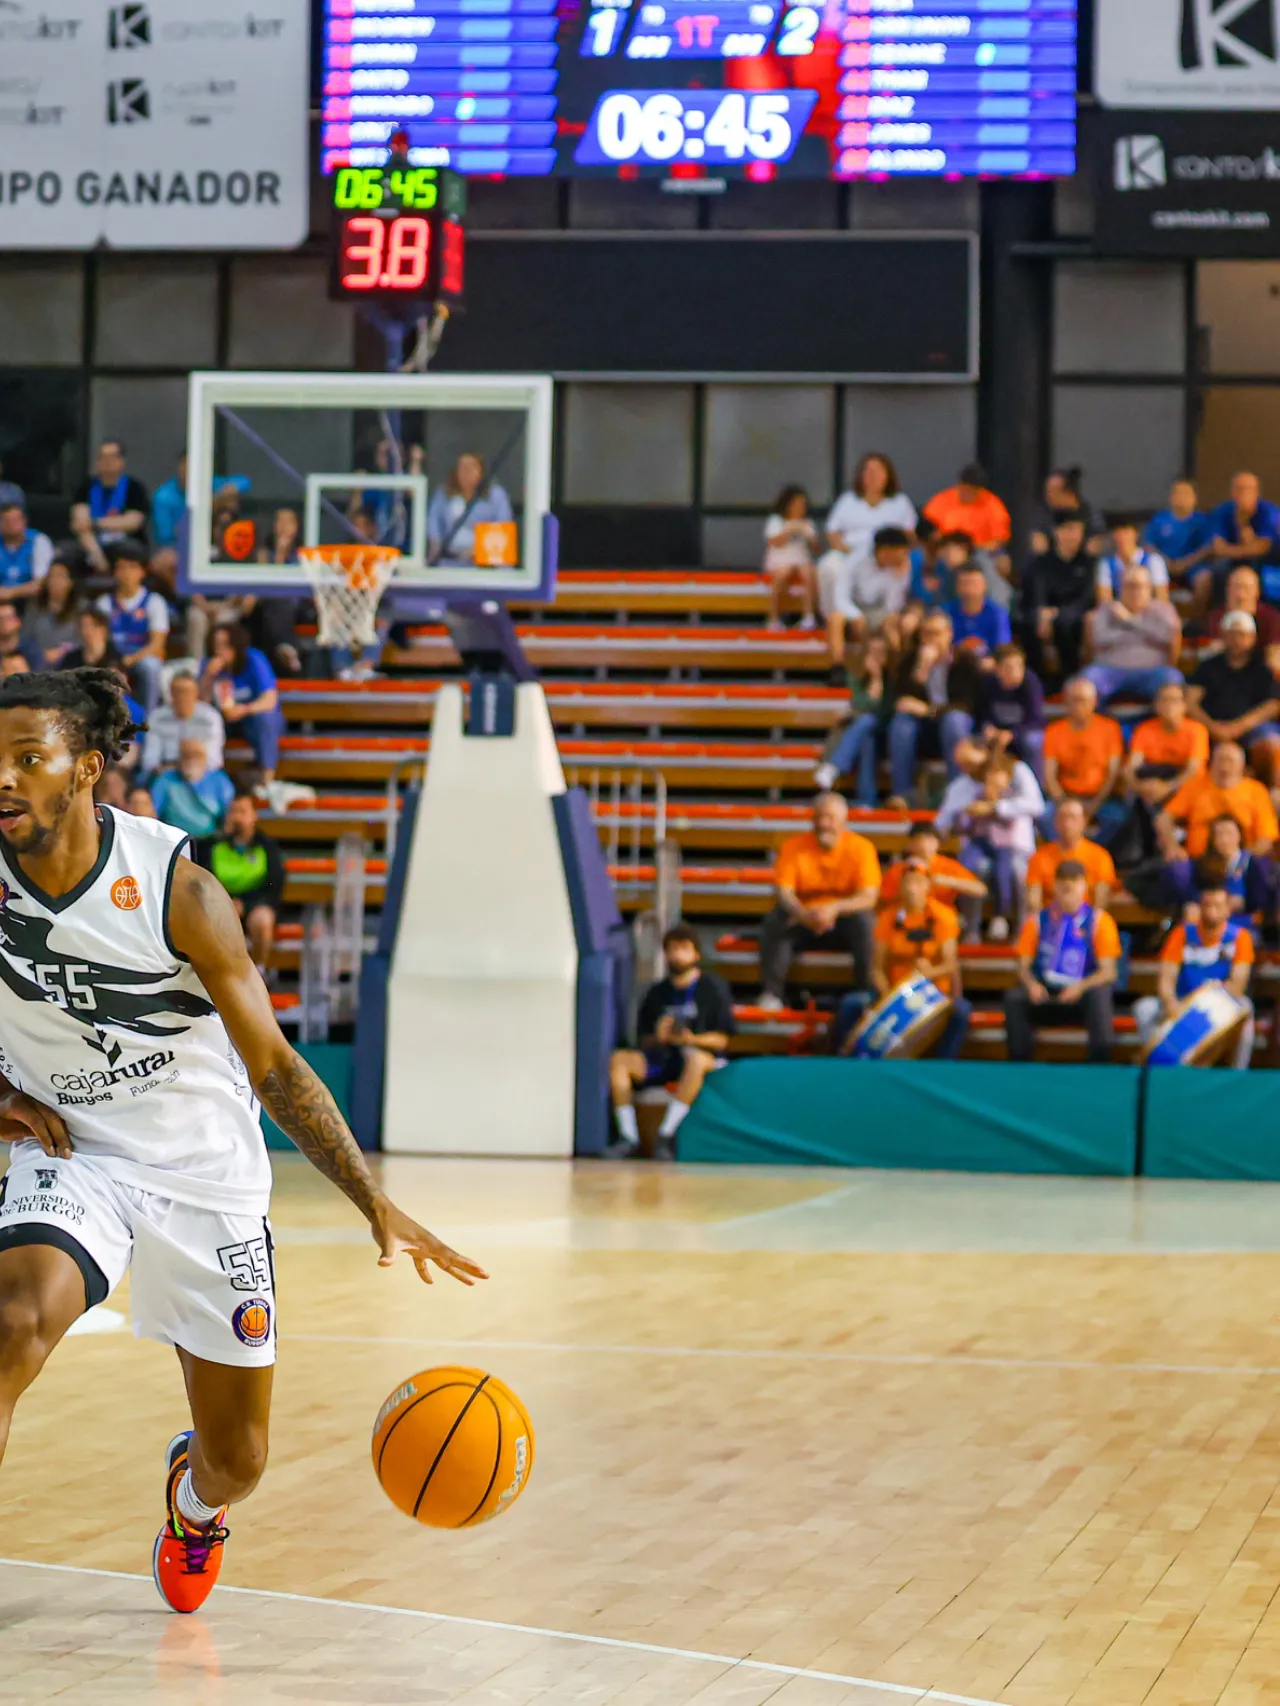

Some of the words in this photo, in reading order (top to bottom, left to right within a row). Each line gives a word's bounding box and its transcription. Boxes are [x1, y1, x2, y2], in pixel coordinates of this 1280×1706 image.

[777, 6, 820, 55] 2
[597, 94, 792, 160] 06:45
[76, 170, 281, 206] GANADOR
[334, 168, 438, 209] 06:45
[342, 216, 431, 290] 3.8
[35, 963, 98, 1011] 55
[17, 1201, 82, 1226] BURGOS
[216, 1237, 271, 1292] 55
